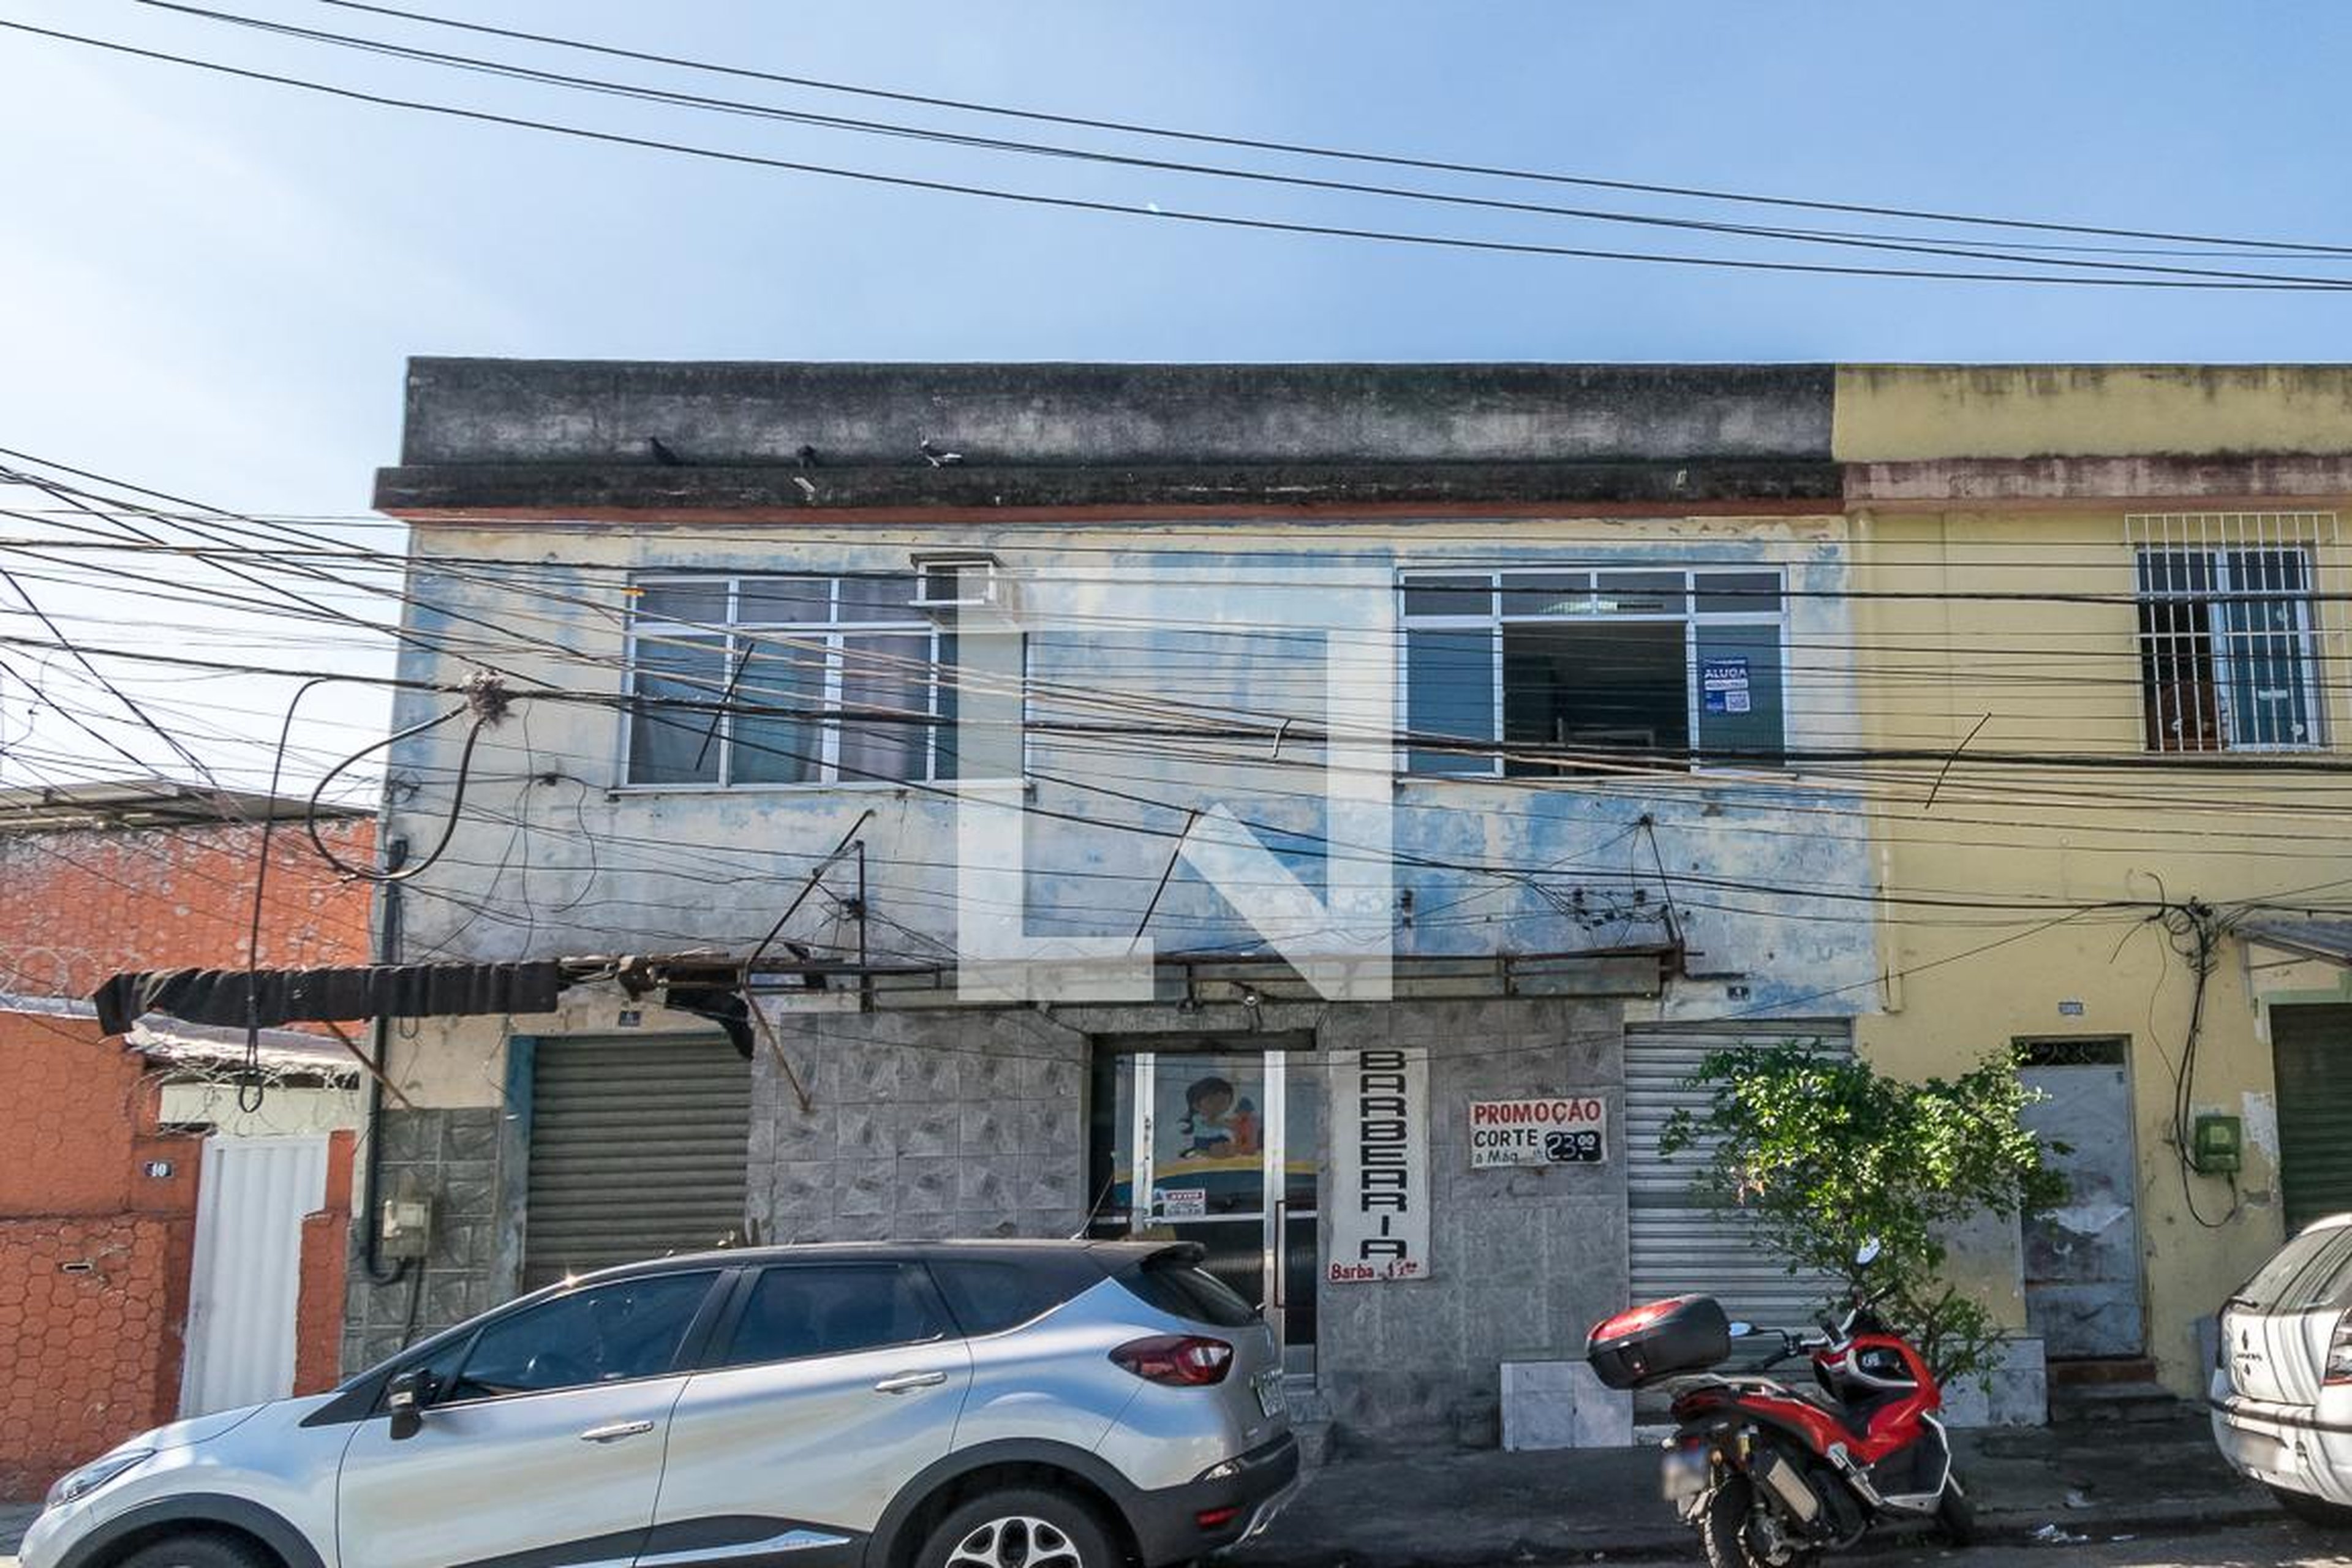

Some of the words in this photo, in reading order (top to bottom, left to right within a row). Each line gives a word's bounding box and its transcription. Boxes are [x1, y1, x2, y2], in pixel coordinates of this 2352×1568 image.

[1474, 1129, 1538, 1147] CORTE
[1360, 1050, 1408, 1260] BARBEARIA
[1332, 1263, 1374, 1280] Barba
